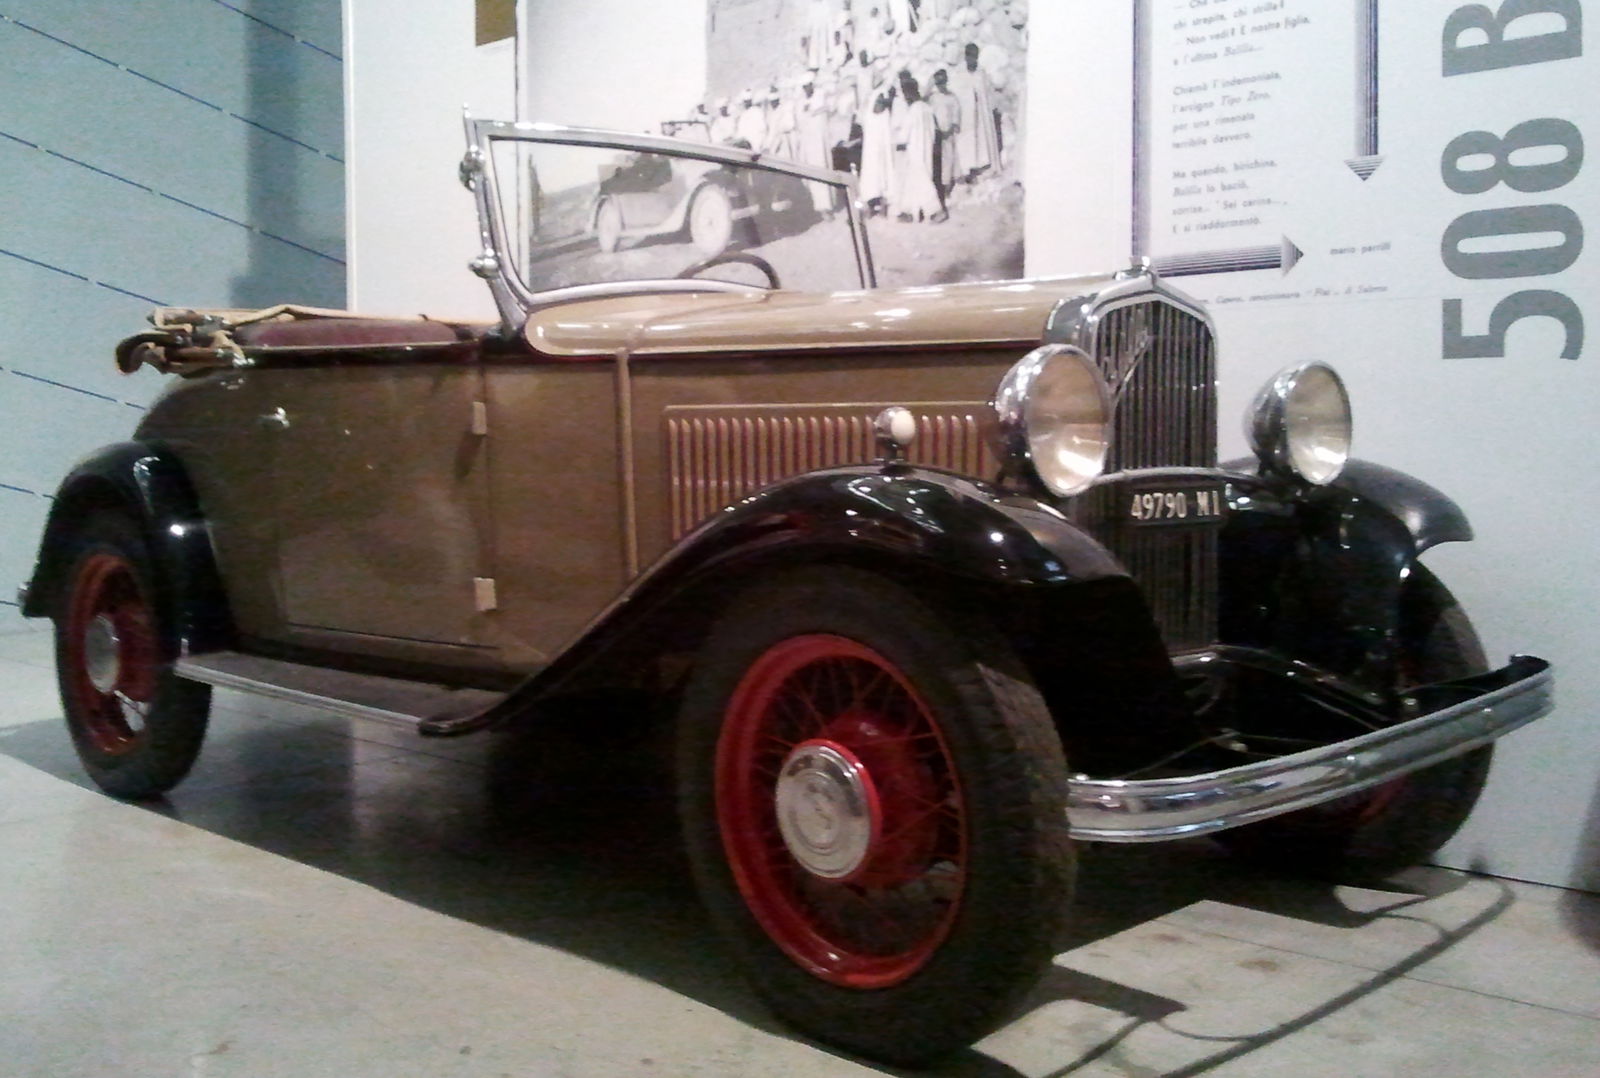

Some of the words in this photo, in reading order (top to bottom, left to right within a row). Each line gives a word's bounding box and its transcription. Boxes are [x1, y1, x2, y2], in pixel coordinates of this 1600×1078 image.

[1442, 0, 1583, 77] B
[1441, 117, 1584, 361] 508
[1131, 492, 1187, 520] 49790
